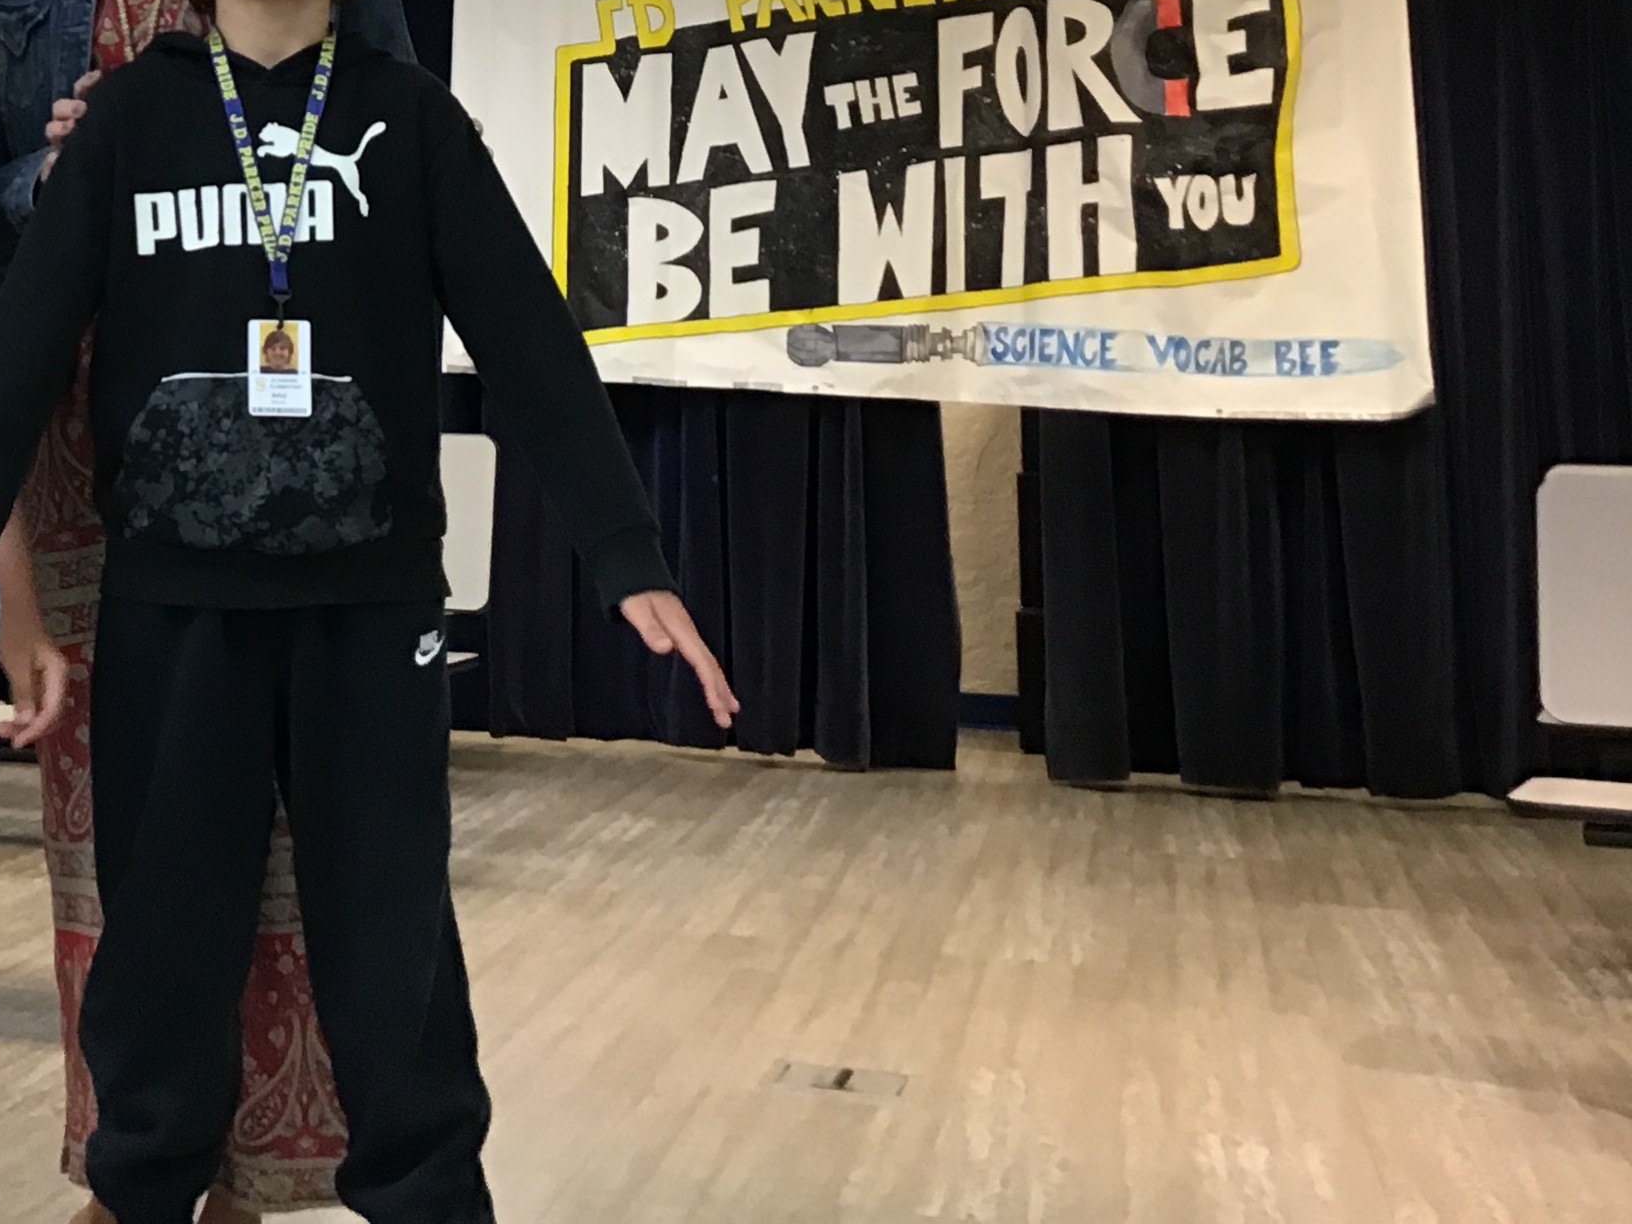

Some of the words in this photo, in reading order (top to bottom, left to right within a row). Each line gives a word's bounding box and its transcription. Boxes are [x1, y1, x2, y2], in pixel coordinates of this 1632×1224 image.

[580, 31, 817, 197] MAY
[823, 71, 922, 130] THE
[238, 145, 268, 212] PARKER
[282, 162, 308, 227] PARKER
[133, 178, 335, 256] PUMA
[626, 179, 778, 328] BE
[838, 133, 1139, 307] WITH
[1152, 173, 1257, 231] YOU
[989, 326, 1118, 369] SCIENCE
[1144, 334, 1249, 376] VOCAB
[1273, 339, 1342, 376] BEE
